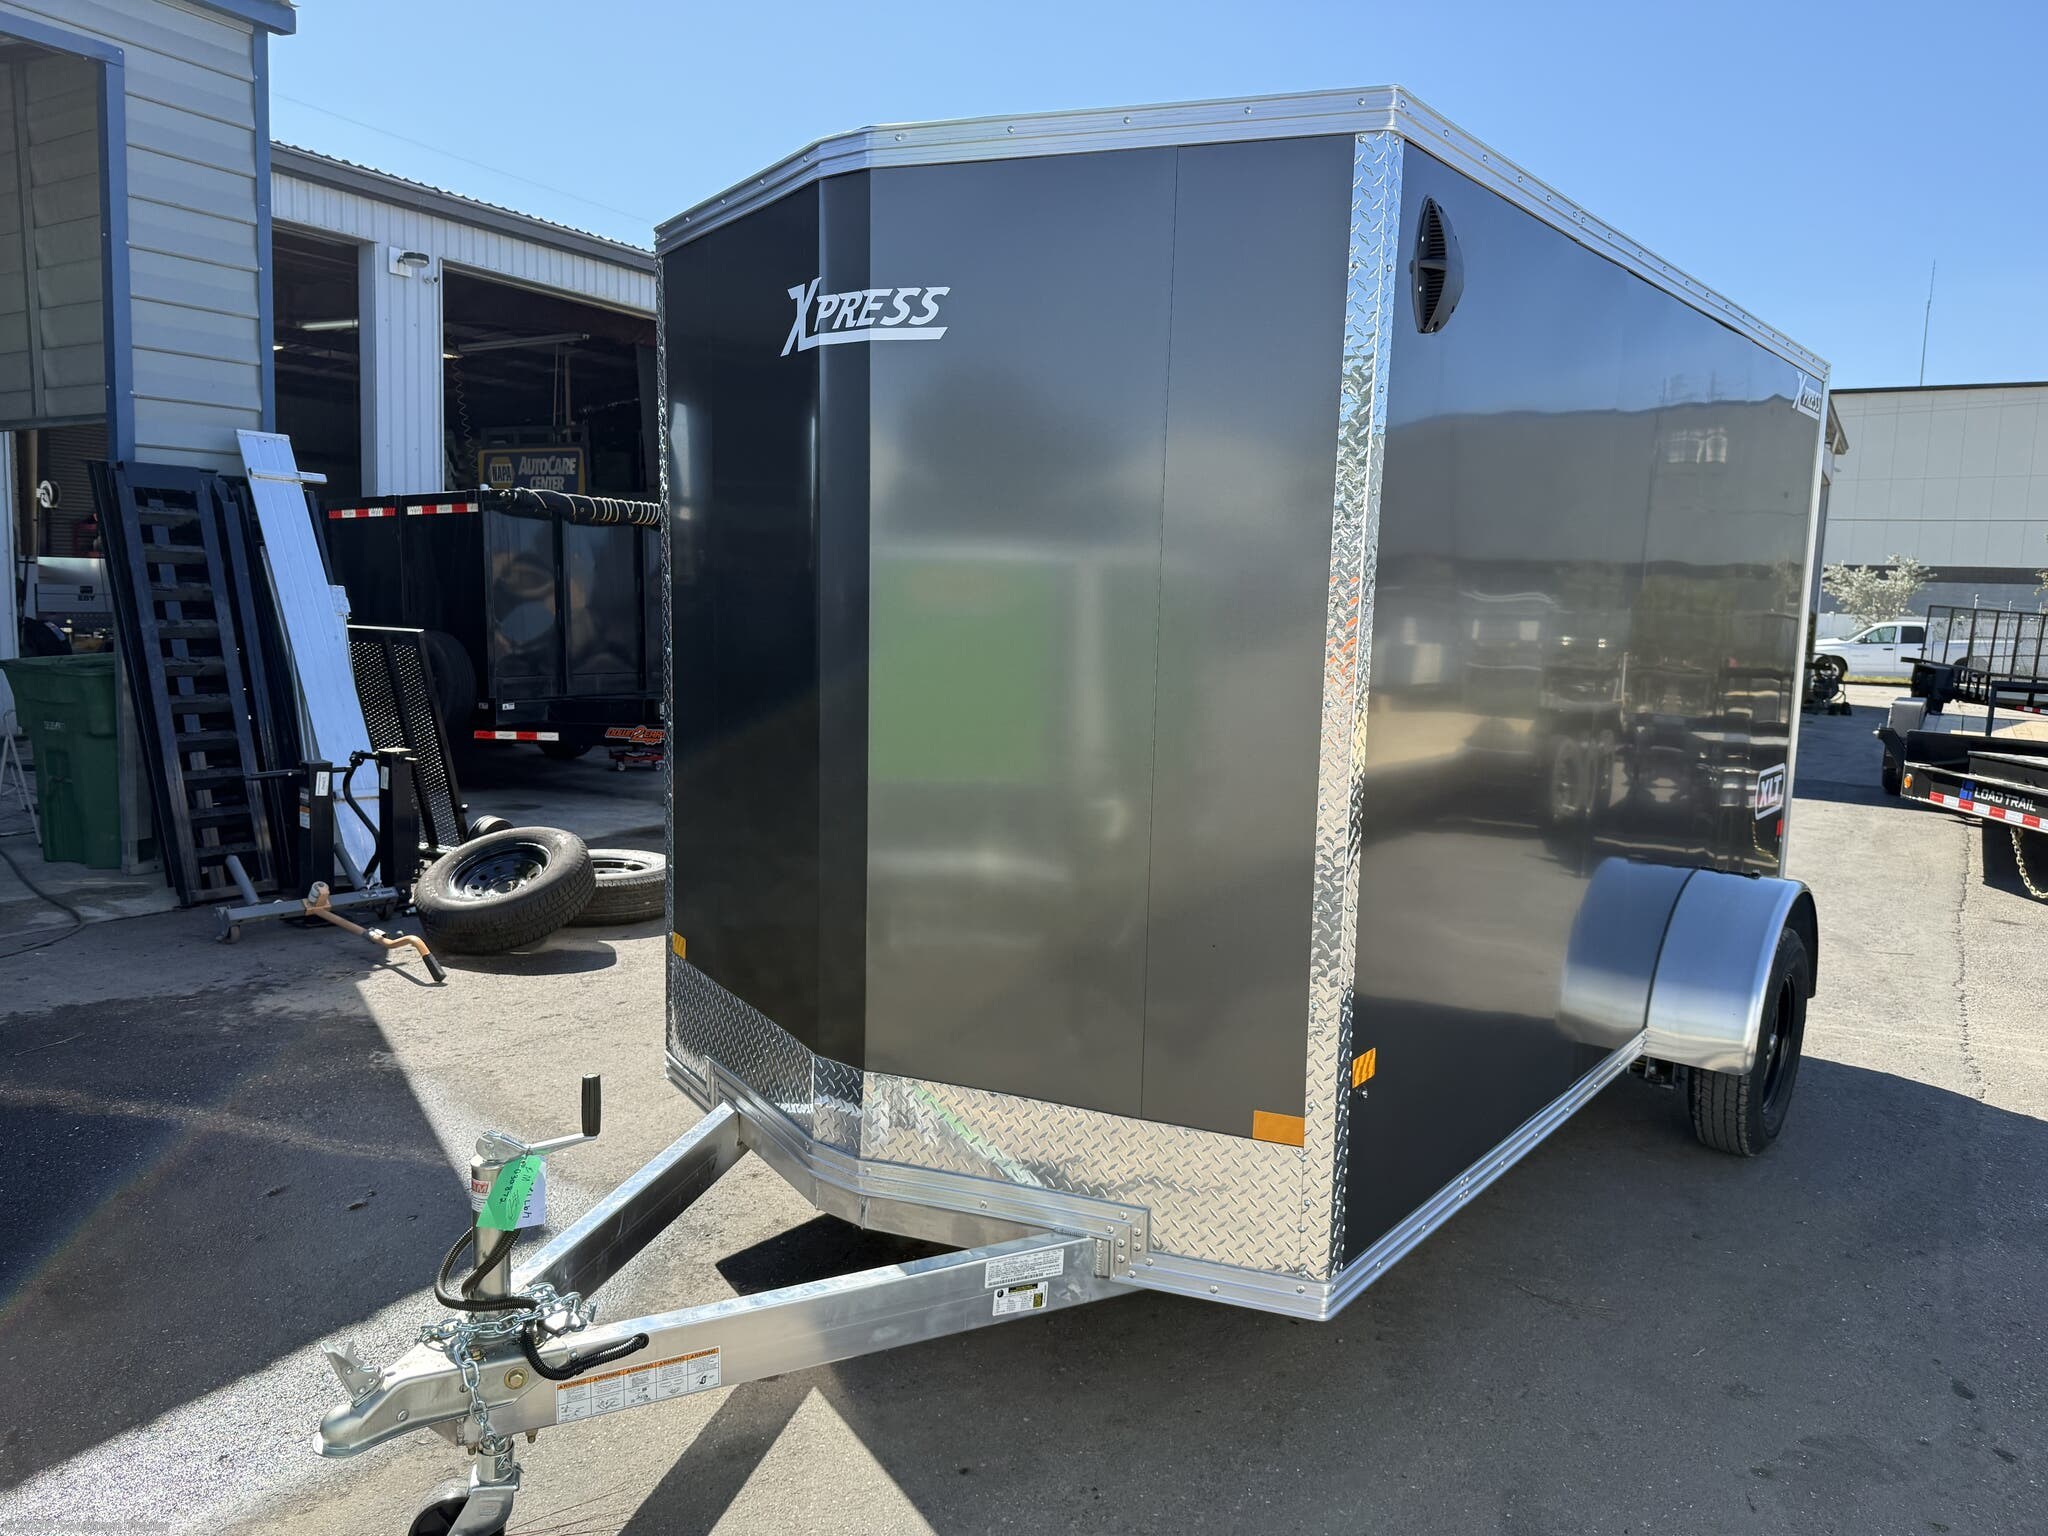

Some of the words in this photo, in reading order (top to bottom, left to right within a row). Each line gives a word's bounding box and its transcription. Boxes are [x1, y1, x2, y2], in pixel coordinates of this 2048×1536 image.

[780, 276, 951, 357] XPRESS
[530, 475, 565, 491] CENTER
[1758, 774, 1783, 809] XLT
[1974, 786, 2004, 804] LOAD
[2005, 793, 2037, 812] TRAIL
